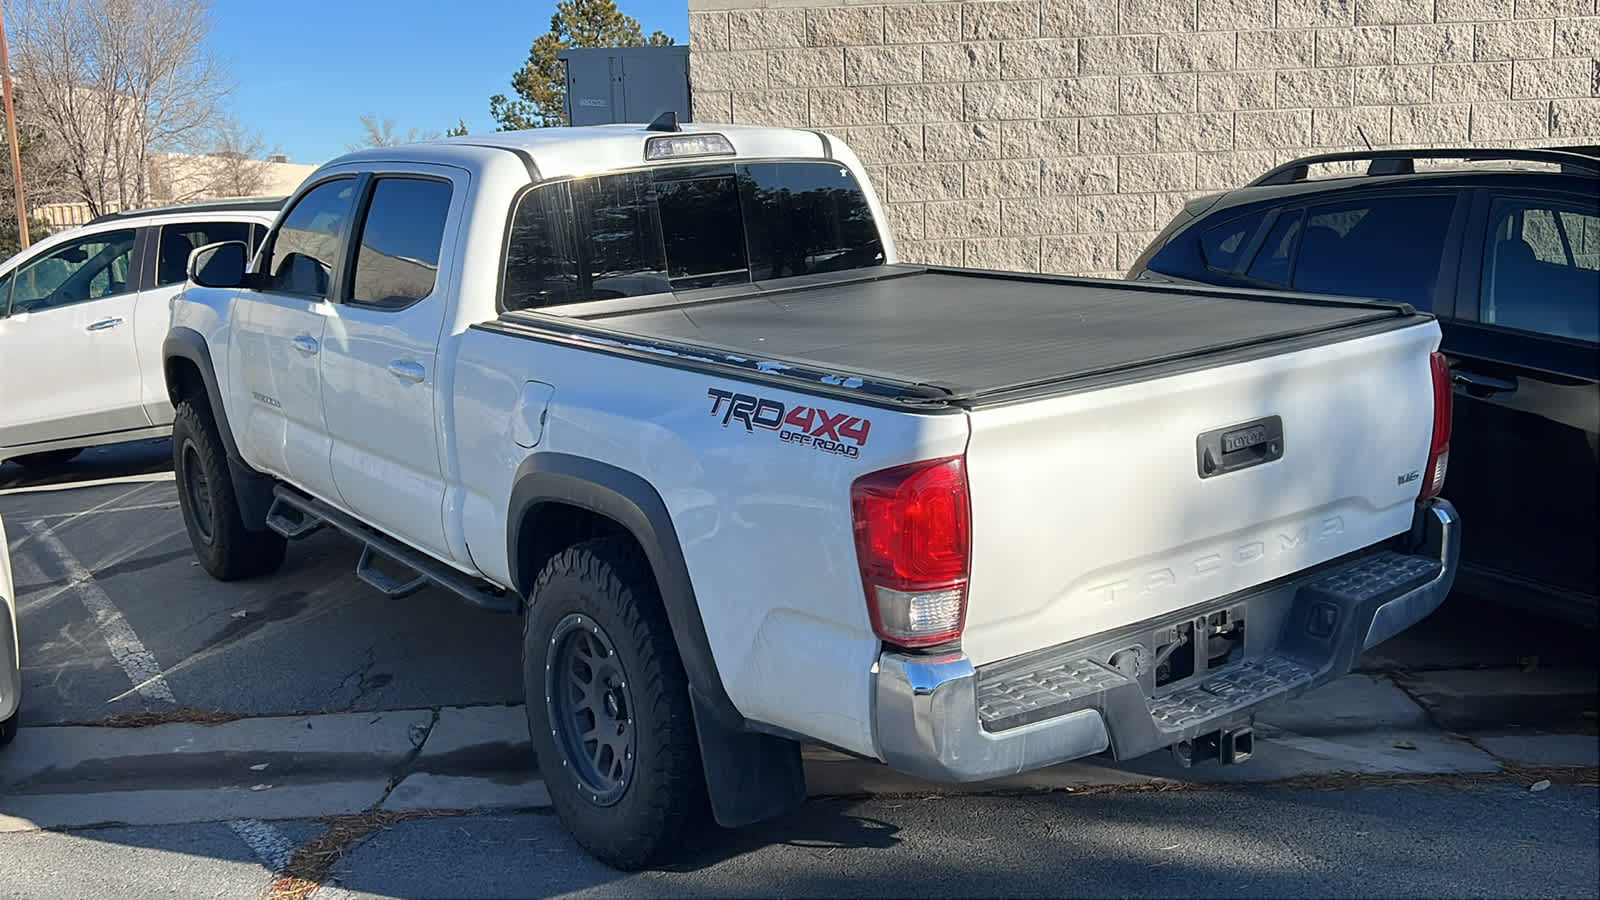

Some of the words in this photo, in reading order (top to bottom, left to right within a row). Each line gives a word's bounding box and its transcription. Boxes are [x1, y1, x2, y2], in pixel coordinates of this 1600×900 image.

[779, 431, 812, 446] OFF
[812, 438, 860, 459] ROAD
[1088, 514, 1344, 602] TACOMA
